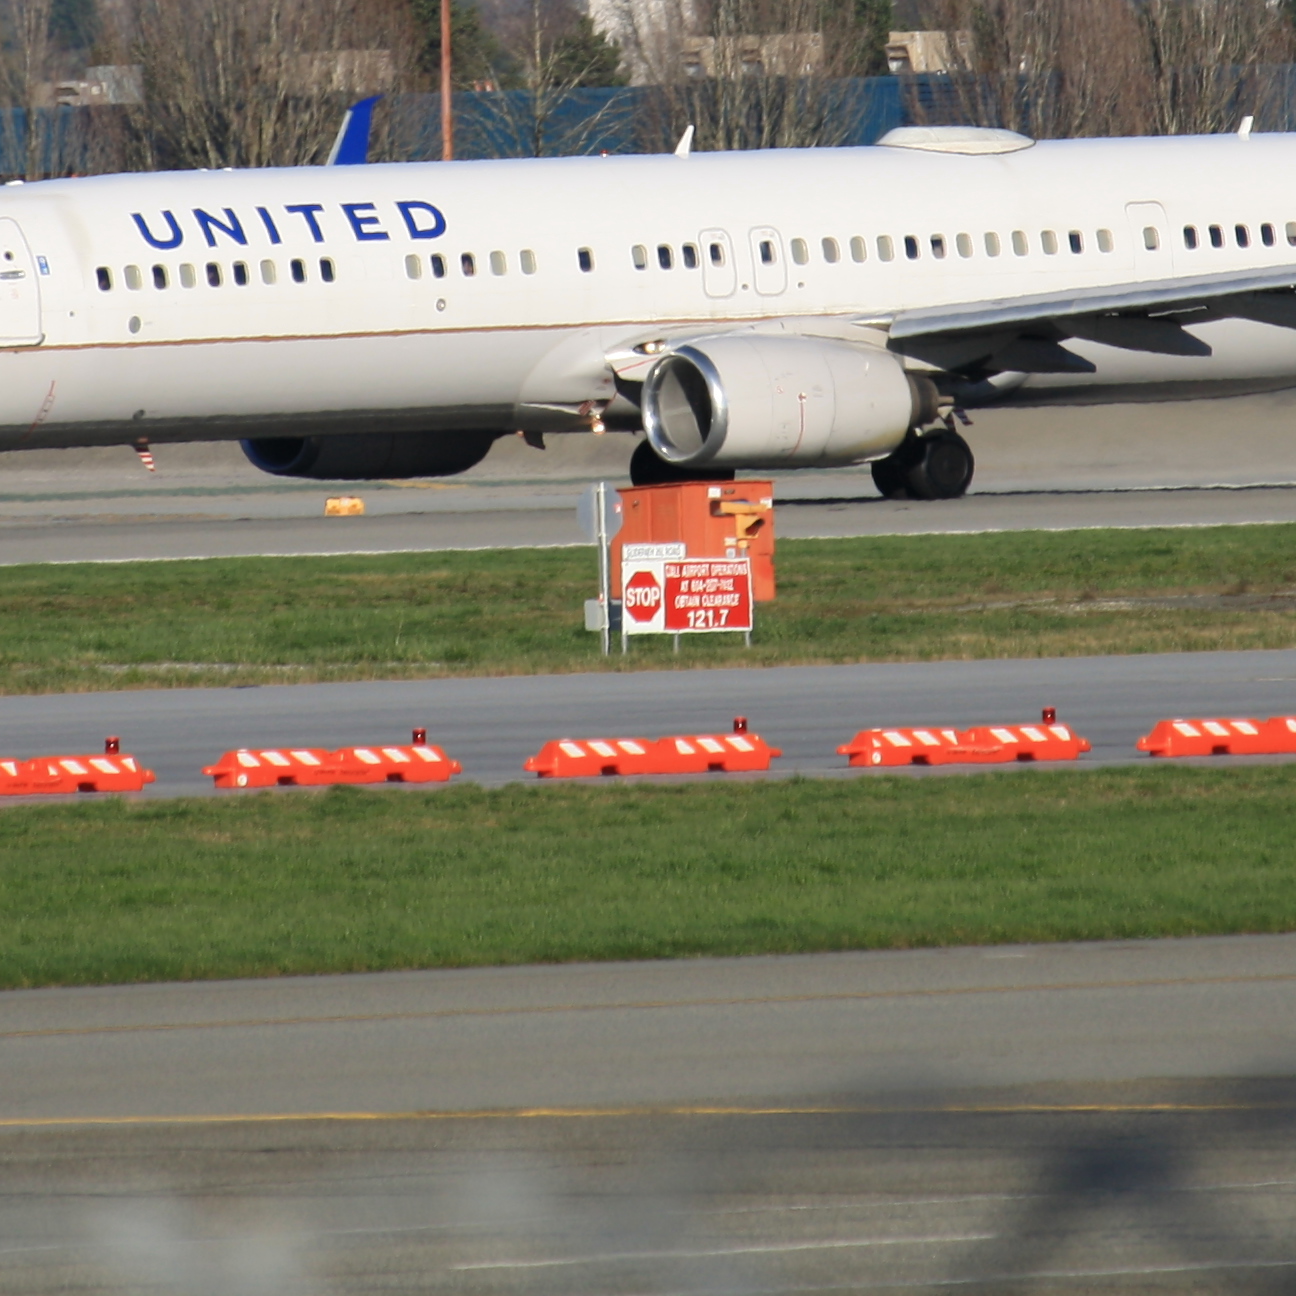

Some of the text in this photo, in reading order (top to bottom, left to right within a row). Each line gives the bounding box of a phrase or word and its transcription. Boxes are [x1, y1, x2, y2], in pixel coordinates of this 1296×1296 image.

[131, 201, 447, 250] UNITED
[681, 564, 710, 578] AIRPORT
[626, 586, 660, 607] STOP
[674, 593, 740, 609] OBTAIN CLEARANCE
[686, 609, 729, 628] 121.7
